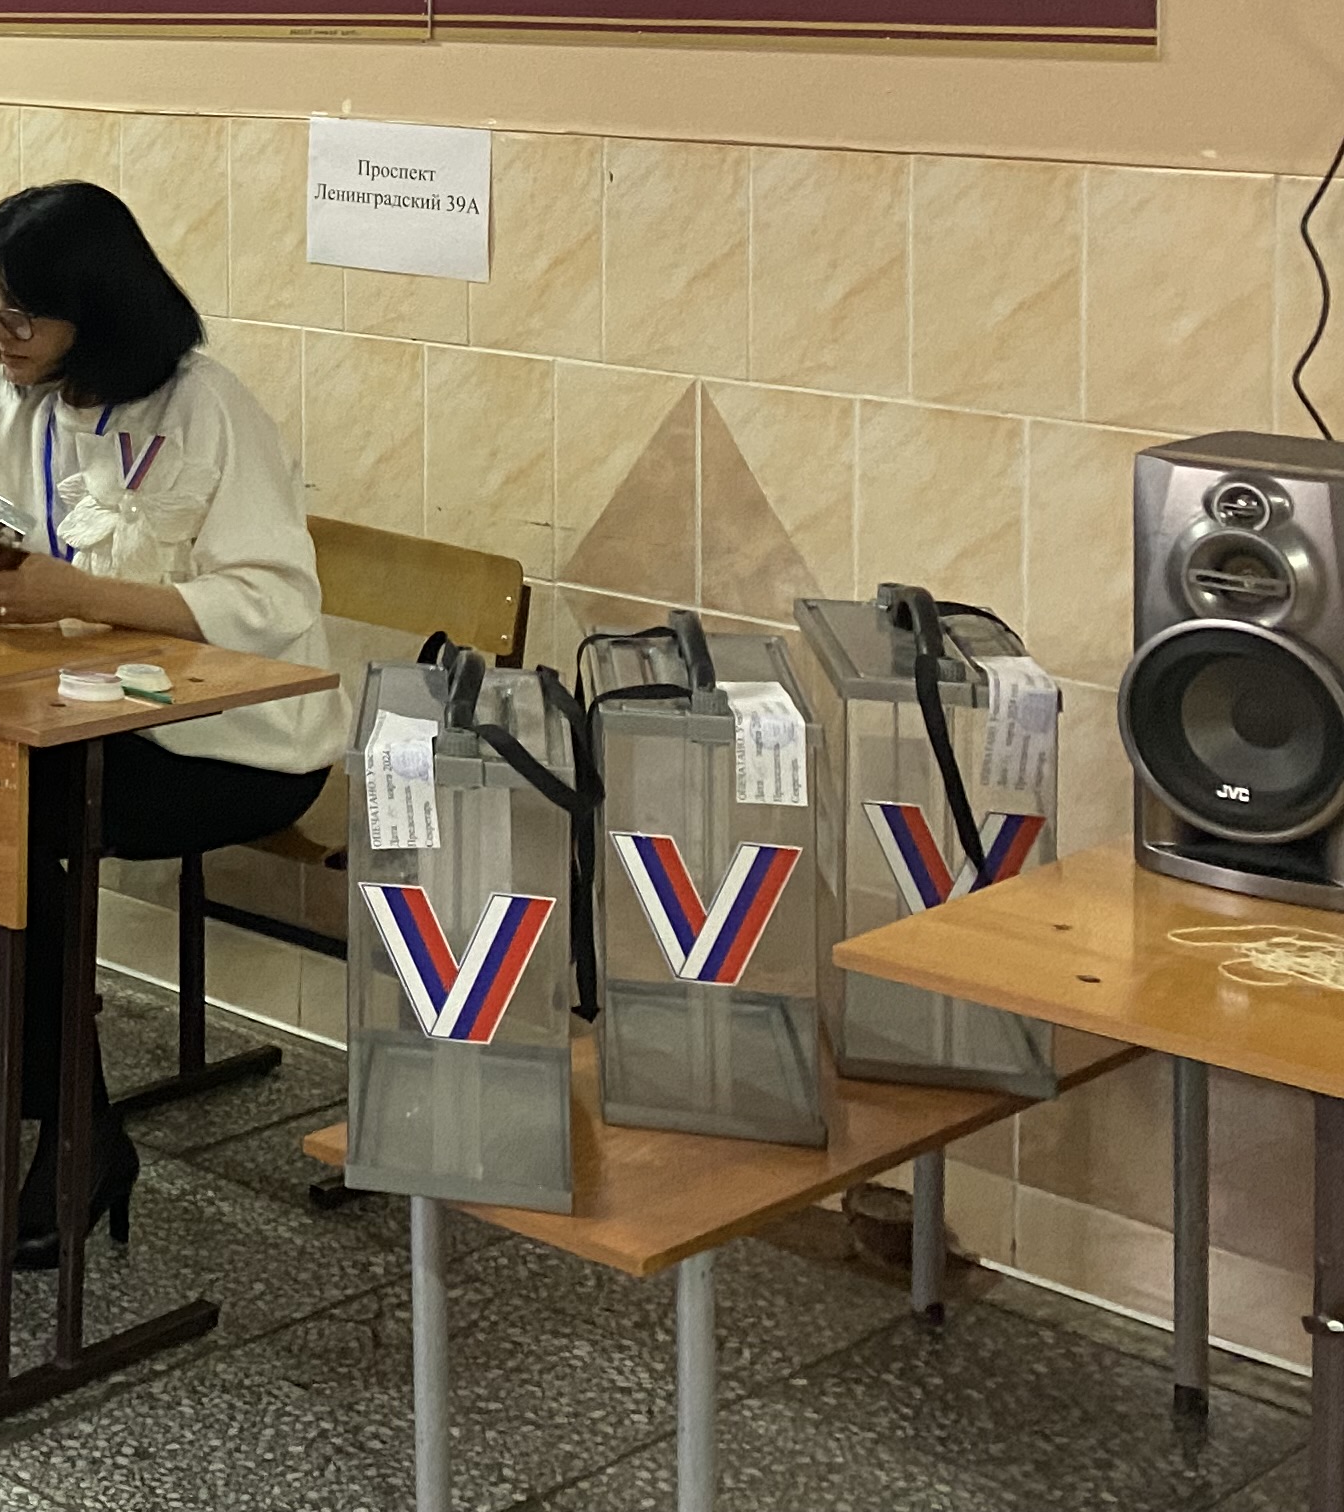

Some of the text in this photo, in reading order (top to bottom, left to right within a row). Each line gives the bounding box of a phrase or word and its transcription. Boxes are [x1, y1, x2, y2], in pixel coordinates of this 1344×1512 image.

[358, 159, 437, 181] Проспект
[314, 183, 481, 215] Ленинградский 39А
[1215, 784, 1250, 802] JVC
